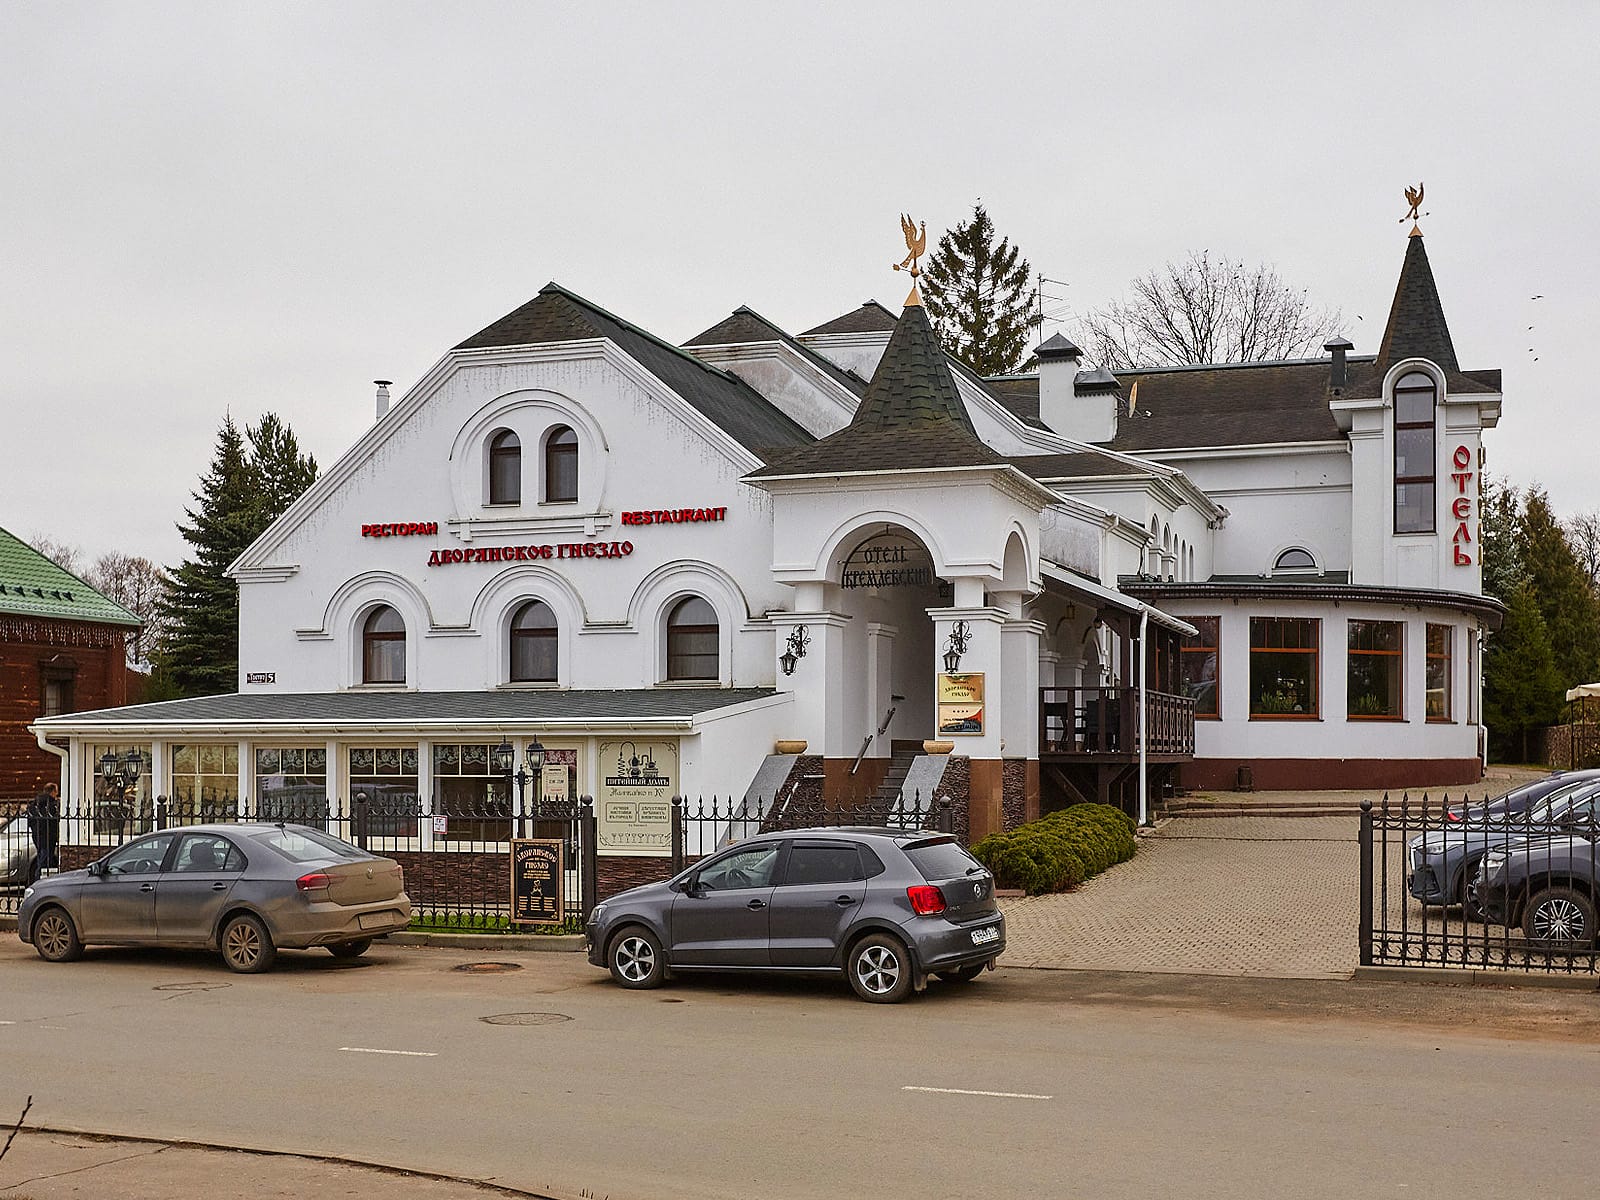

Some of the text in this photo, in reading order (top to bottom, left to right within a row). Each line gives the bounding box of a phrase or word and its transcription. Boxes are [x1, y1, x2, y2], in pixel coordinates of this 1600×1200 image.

[621, 506, 728, 526] RESTAURANT
[1451, 445, 1473, 566] ОТЕЛЬ
[361, 521, 439, 538] РЕСТОРАН
[427, 540, 634, 567] ДВОРЯНСКОЕ ГНЕЗДО
